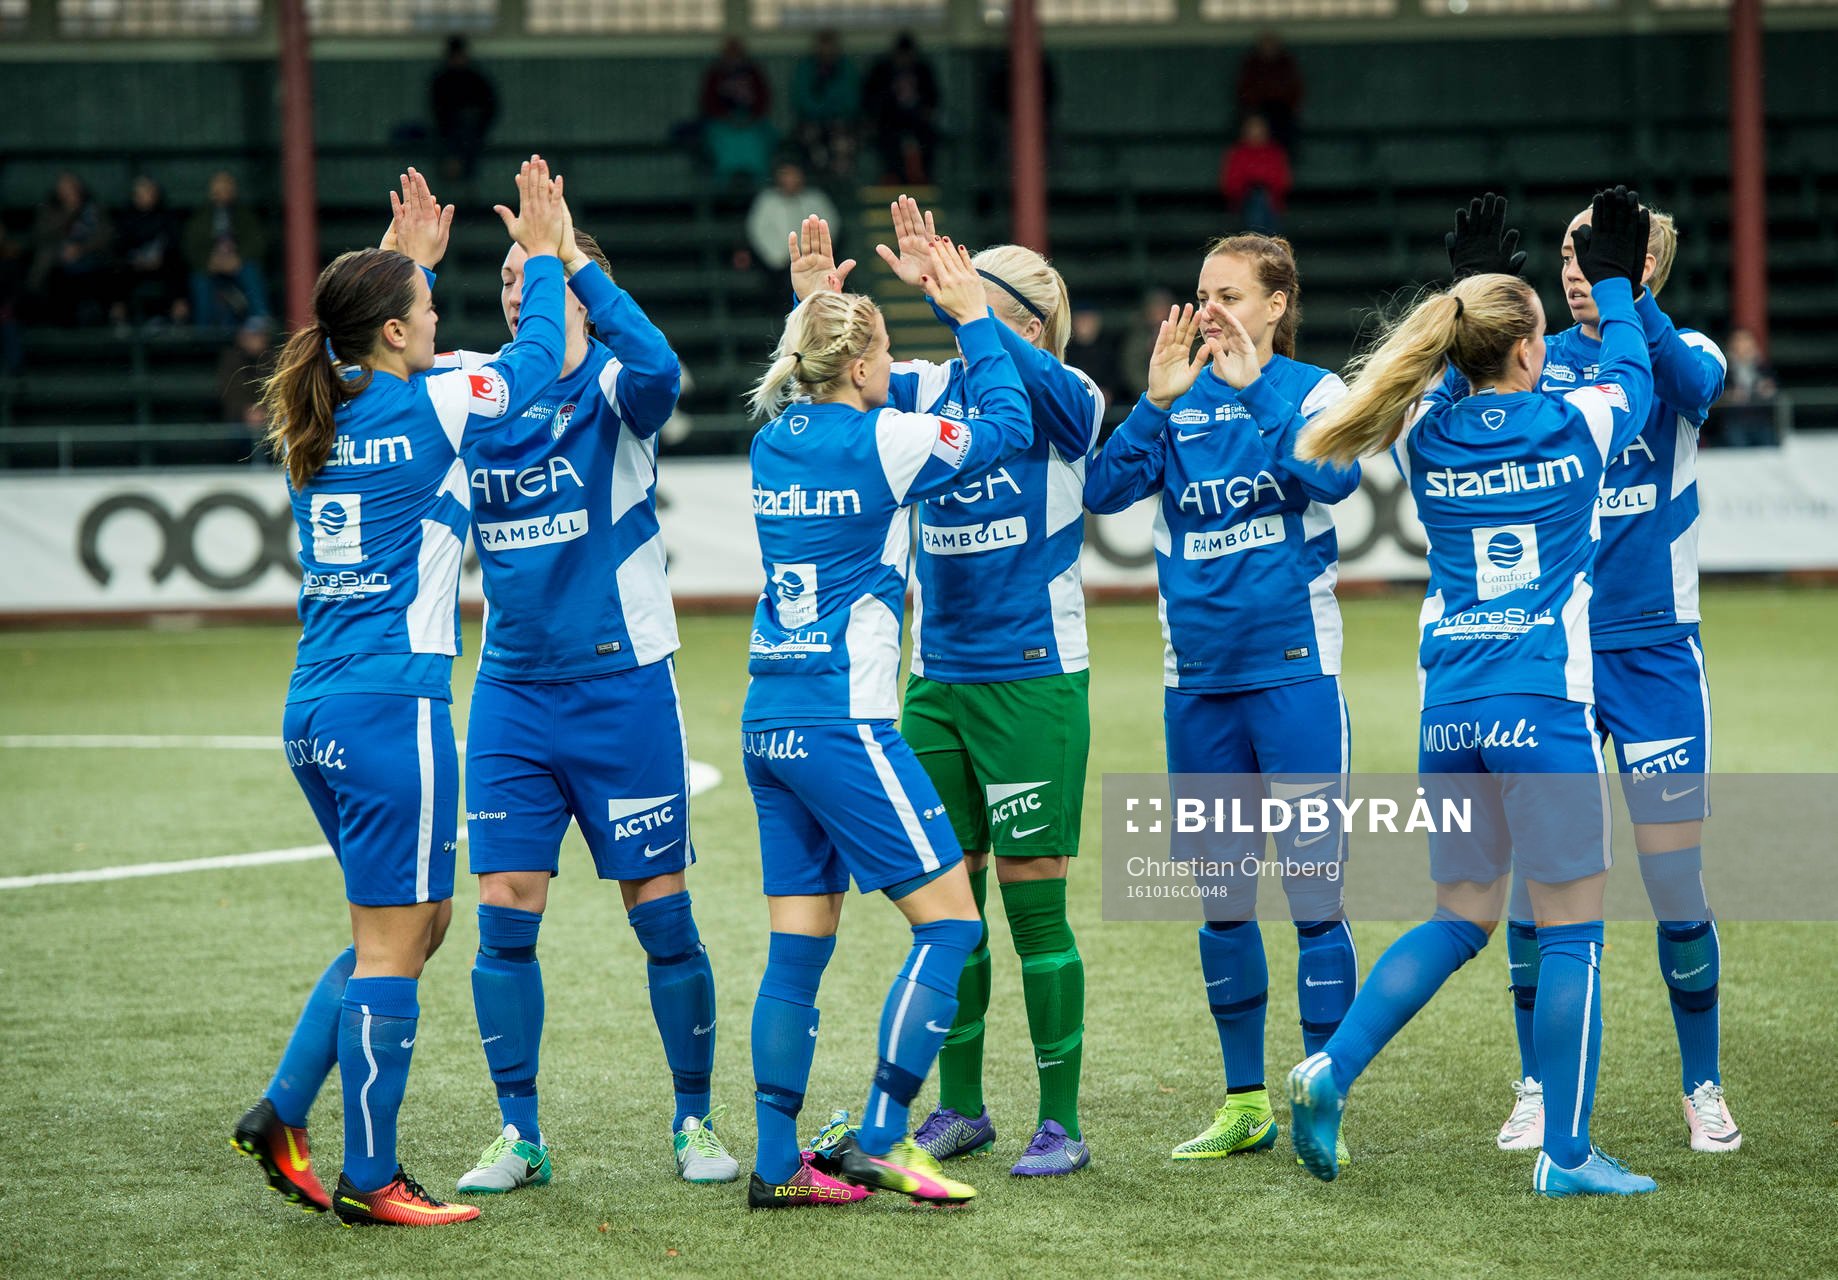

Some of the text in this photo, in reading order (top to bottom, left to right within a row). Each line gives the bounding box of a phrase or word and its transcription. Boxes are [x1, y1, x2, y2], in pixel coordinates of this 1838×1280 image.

[326, 435, 413, 466] dium
[471, 456, 584, 503] ATEA
[1180, 470, 1286, 515] ATEA
[1426, 454, 1584, 497] stadium
[1482, 569, 1533, 583] Comfort
[1632, 748, 1689, 785] ACTIC
[479, 811, 507, 820] Group
[615, 806, 674, 841] ACTIC
[992, 793, 1042, 826] ACTIC
[775, 1186, 852, 1200] EVOSPEED
